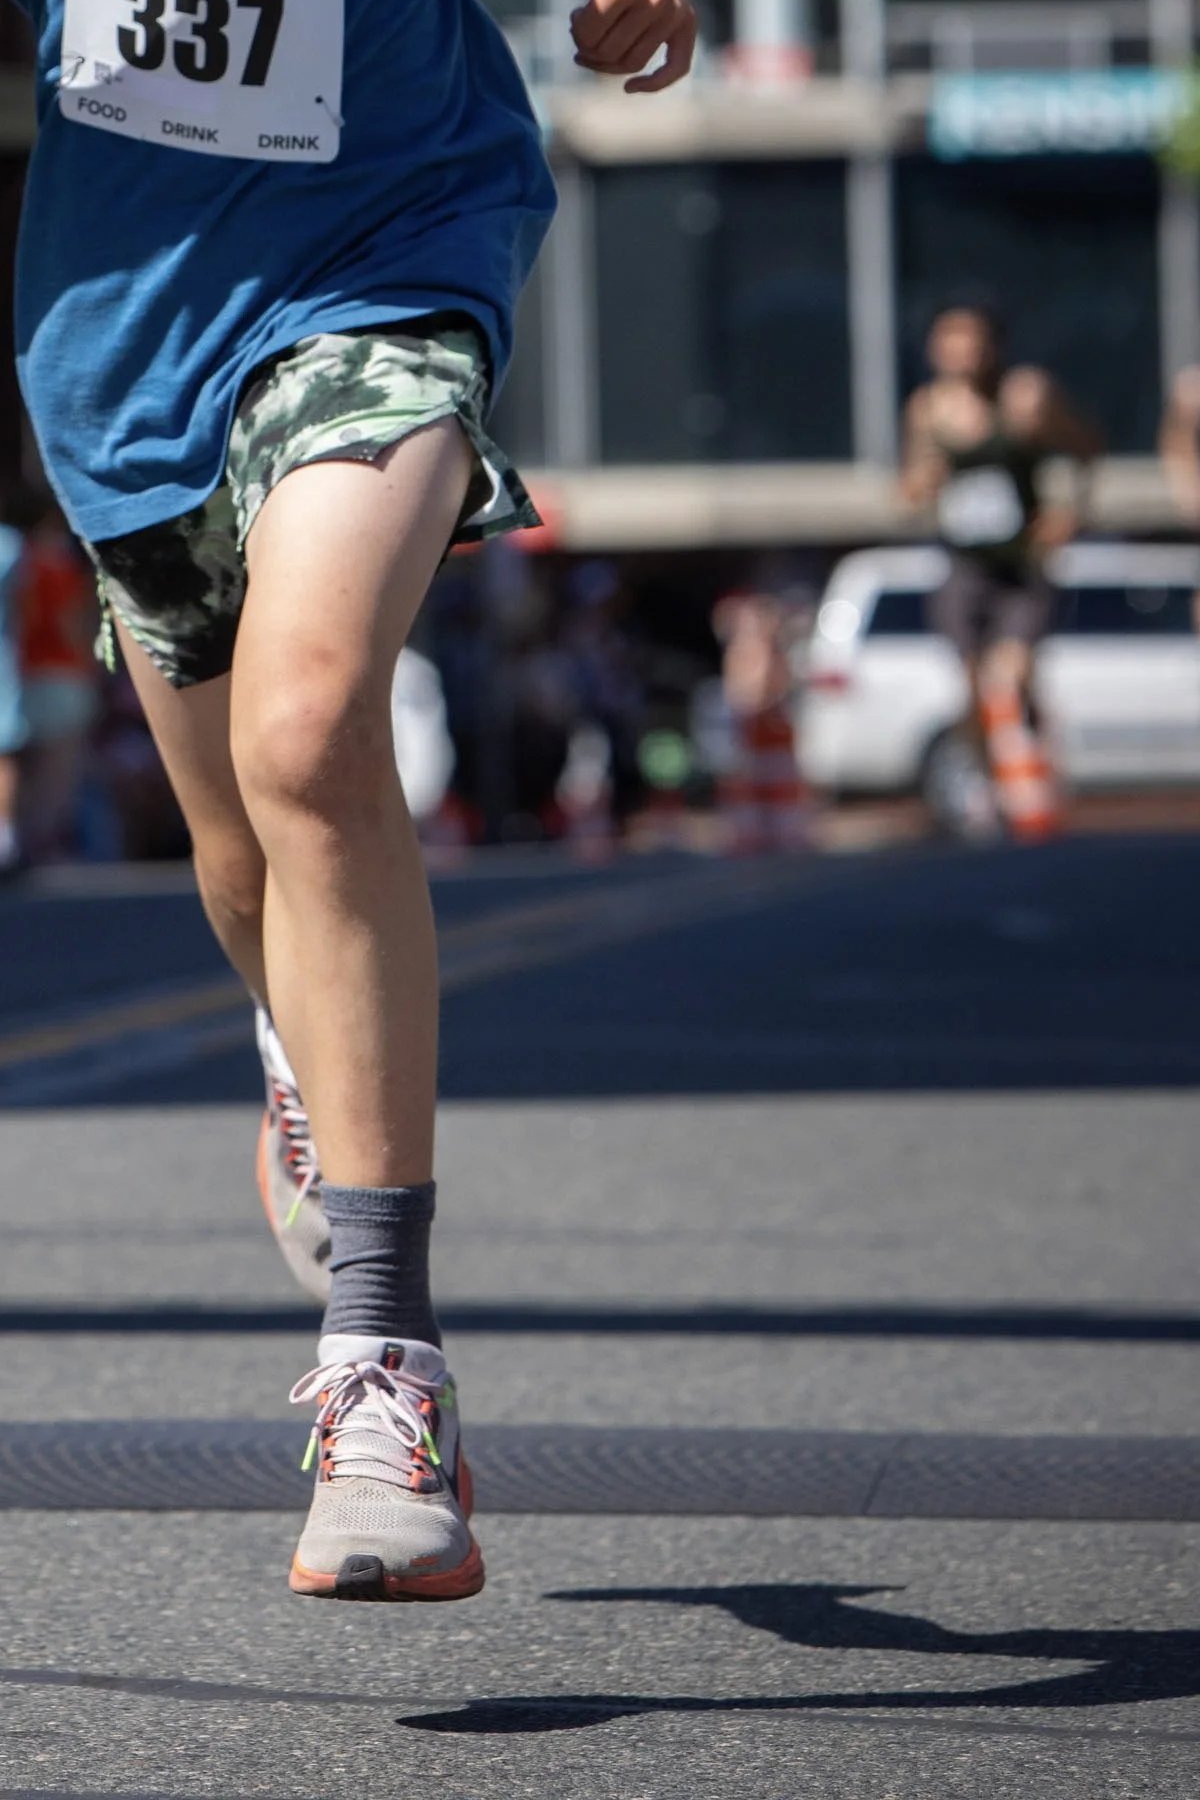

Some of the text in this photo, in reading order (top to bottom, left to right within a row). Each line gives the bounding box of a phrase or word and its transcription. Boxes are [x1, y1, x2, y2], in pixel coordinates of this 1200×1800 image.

[77, 97, 128, 123] FOOD
[161, 120, 220, 144] DRINK
[257, 134, 320, 151] DRINK
